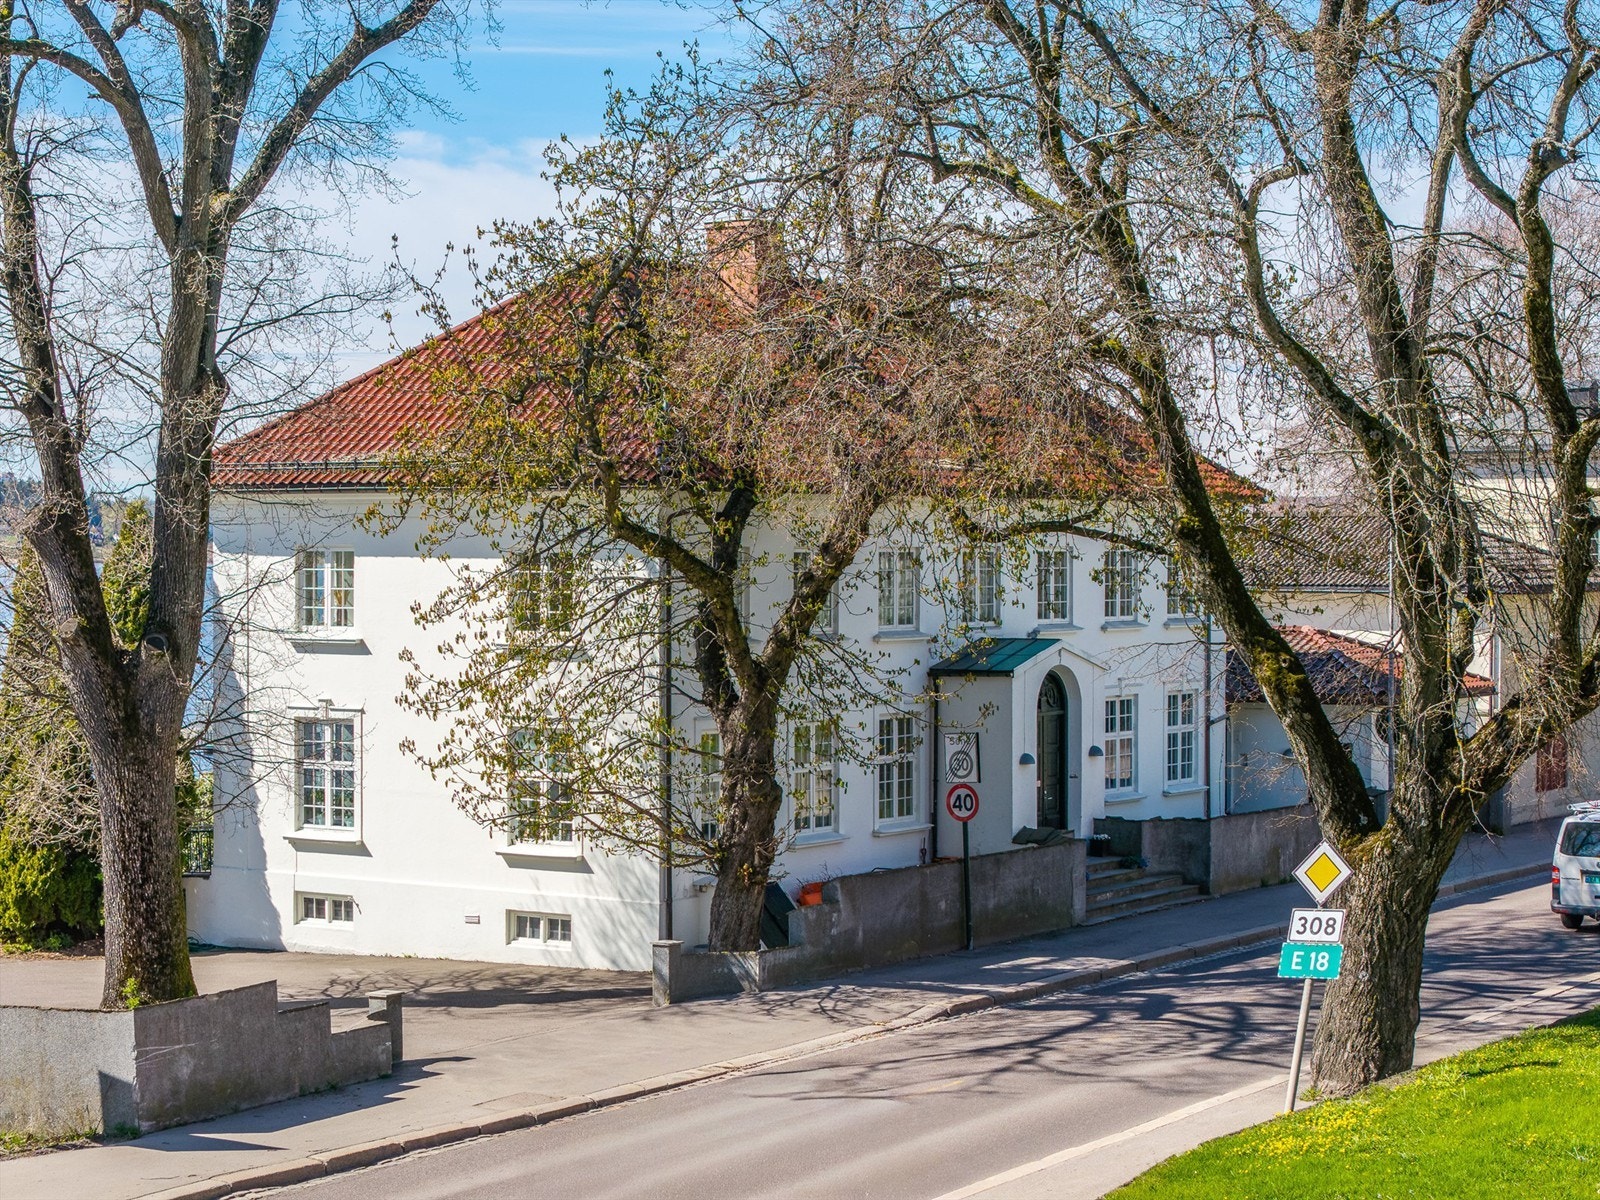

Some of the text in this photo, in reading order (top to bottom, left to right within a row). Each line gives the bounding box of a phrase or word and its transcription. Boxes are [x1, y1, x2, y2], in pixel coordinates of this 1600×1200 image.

[953, 793, 974, 811] 40
[1296, 916, 1337, 936] 308
[1291, 951, 1329, 971] E 18
